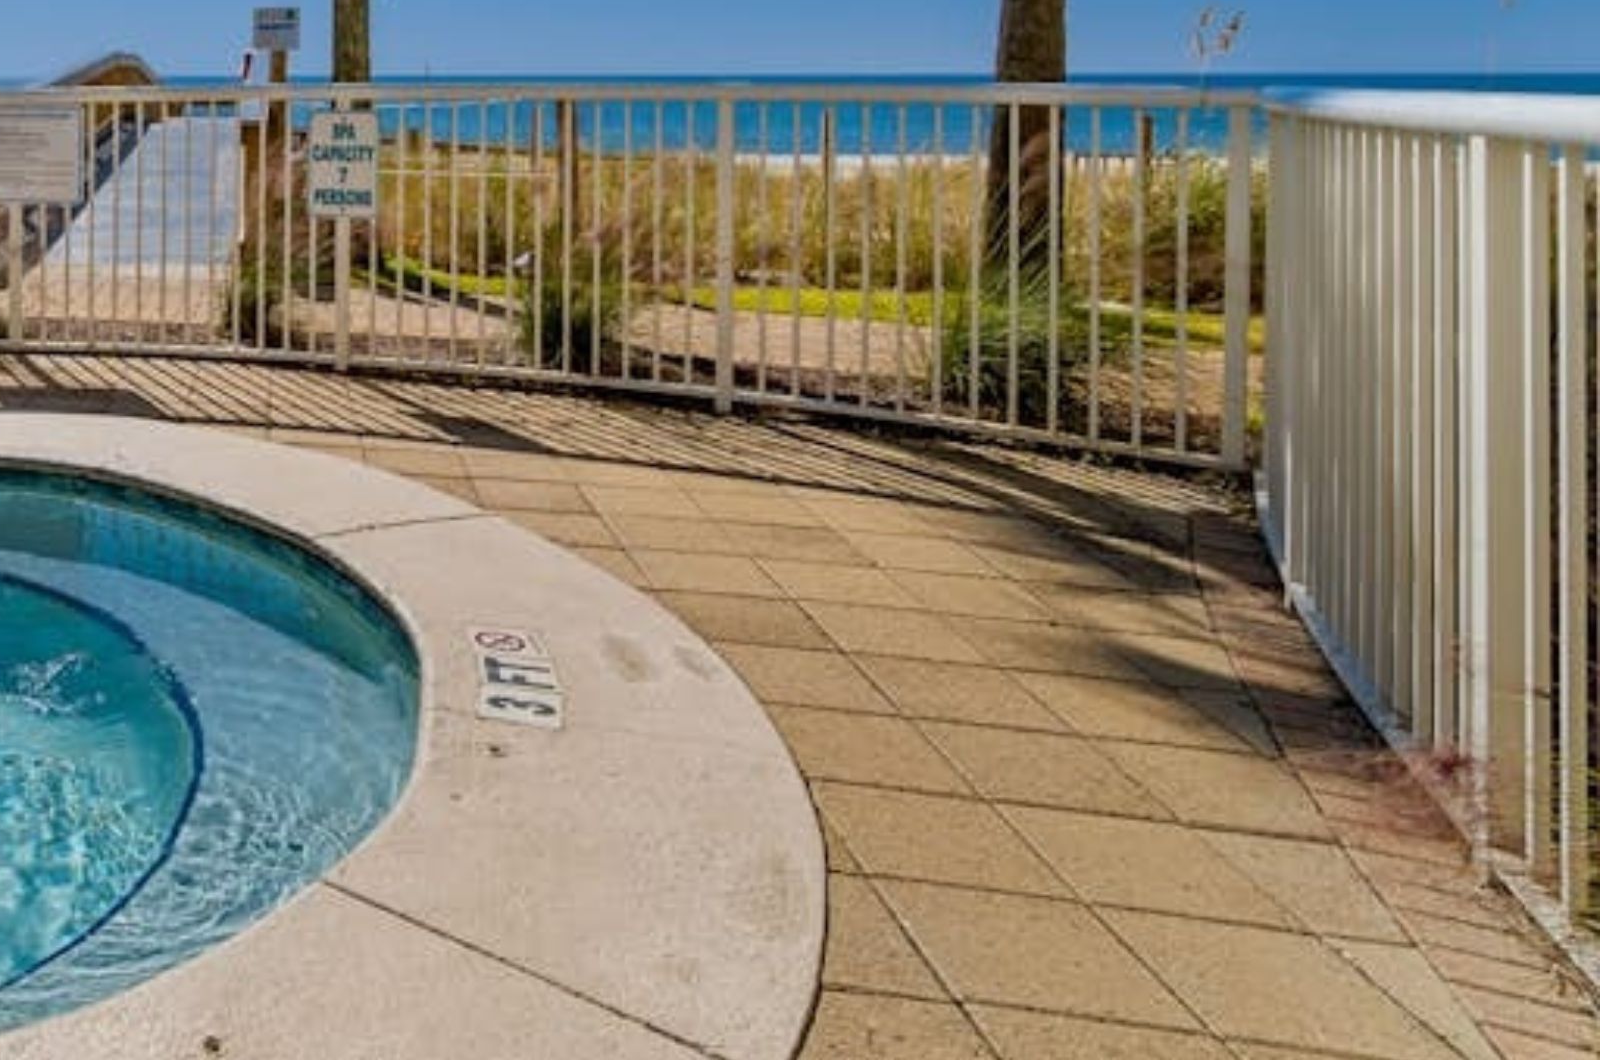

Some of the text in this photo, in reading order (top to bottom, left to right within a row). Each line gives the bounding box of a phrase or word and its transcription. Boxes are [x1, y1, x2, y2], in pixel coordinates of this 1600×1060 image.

[332, 122, 356, 139] SPA
[312, 145, 374, 162] CAPACITY
[314, 188, 372, 206] PERSONS
[483, 656, 557, 717] 3 FT
